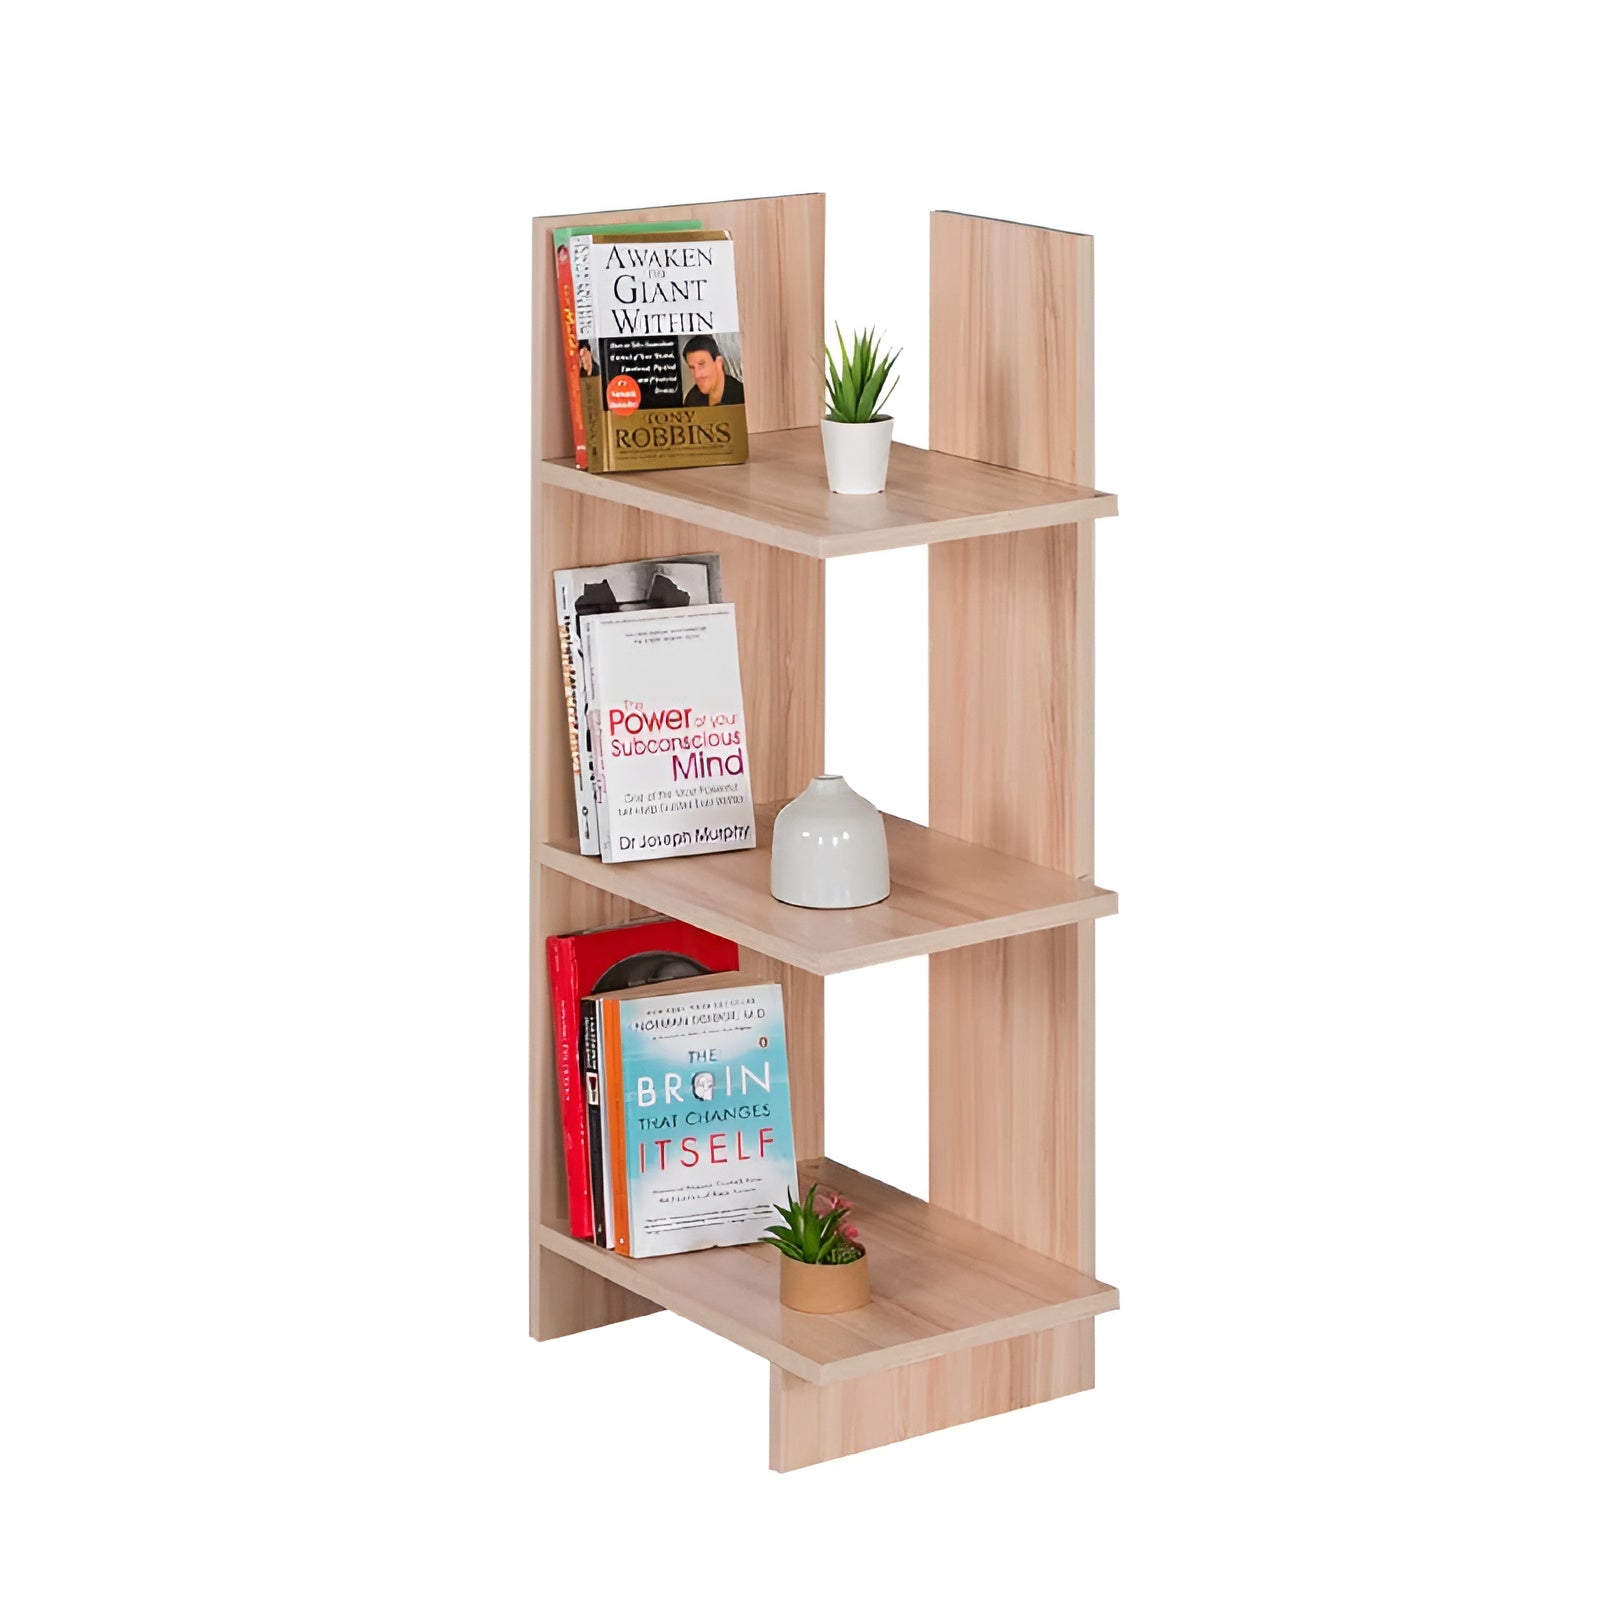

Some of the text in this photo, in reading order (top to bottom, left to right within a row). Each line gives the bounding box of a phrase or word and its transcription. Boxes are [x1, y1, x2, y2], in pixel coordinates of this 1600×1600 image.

[605, 245, 713, 269] AWAKEN
[613, 274, 708, 304] GIANT
[611, 309, 713, 334] WITHIN
[645, 410, 696, 425] TONY
[616, 422, 731, 449] ROBBINS
[609, 708, 693, 736] Power
[710, 713, 738, 729] you
[611, 730, 741, 757] Subconscious
[672, 747, 744, 782] Mind
[619, 825, 751, 850] Dr Joseph Murphy
[688, 1049, 718, 1064] THE
[637, 1061, 771, 1107] BRIN
[638, 1103, 771, 1131] THAT CHANGES
[639, 1127, 774, 1174] ITSELF
